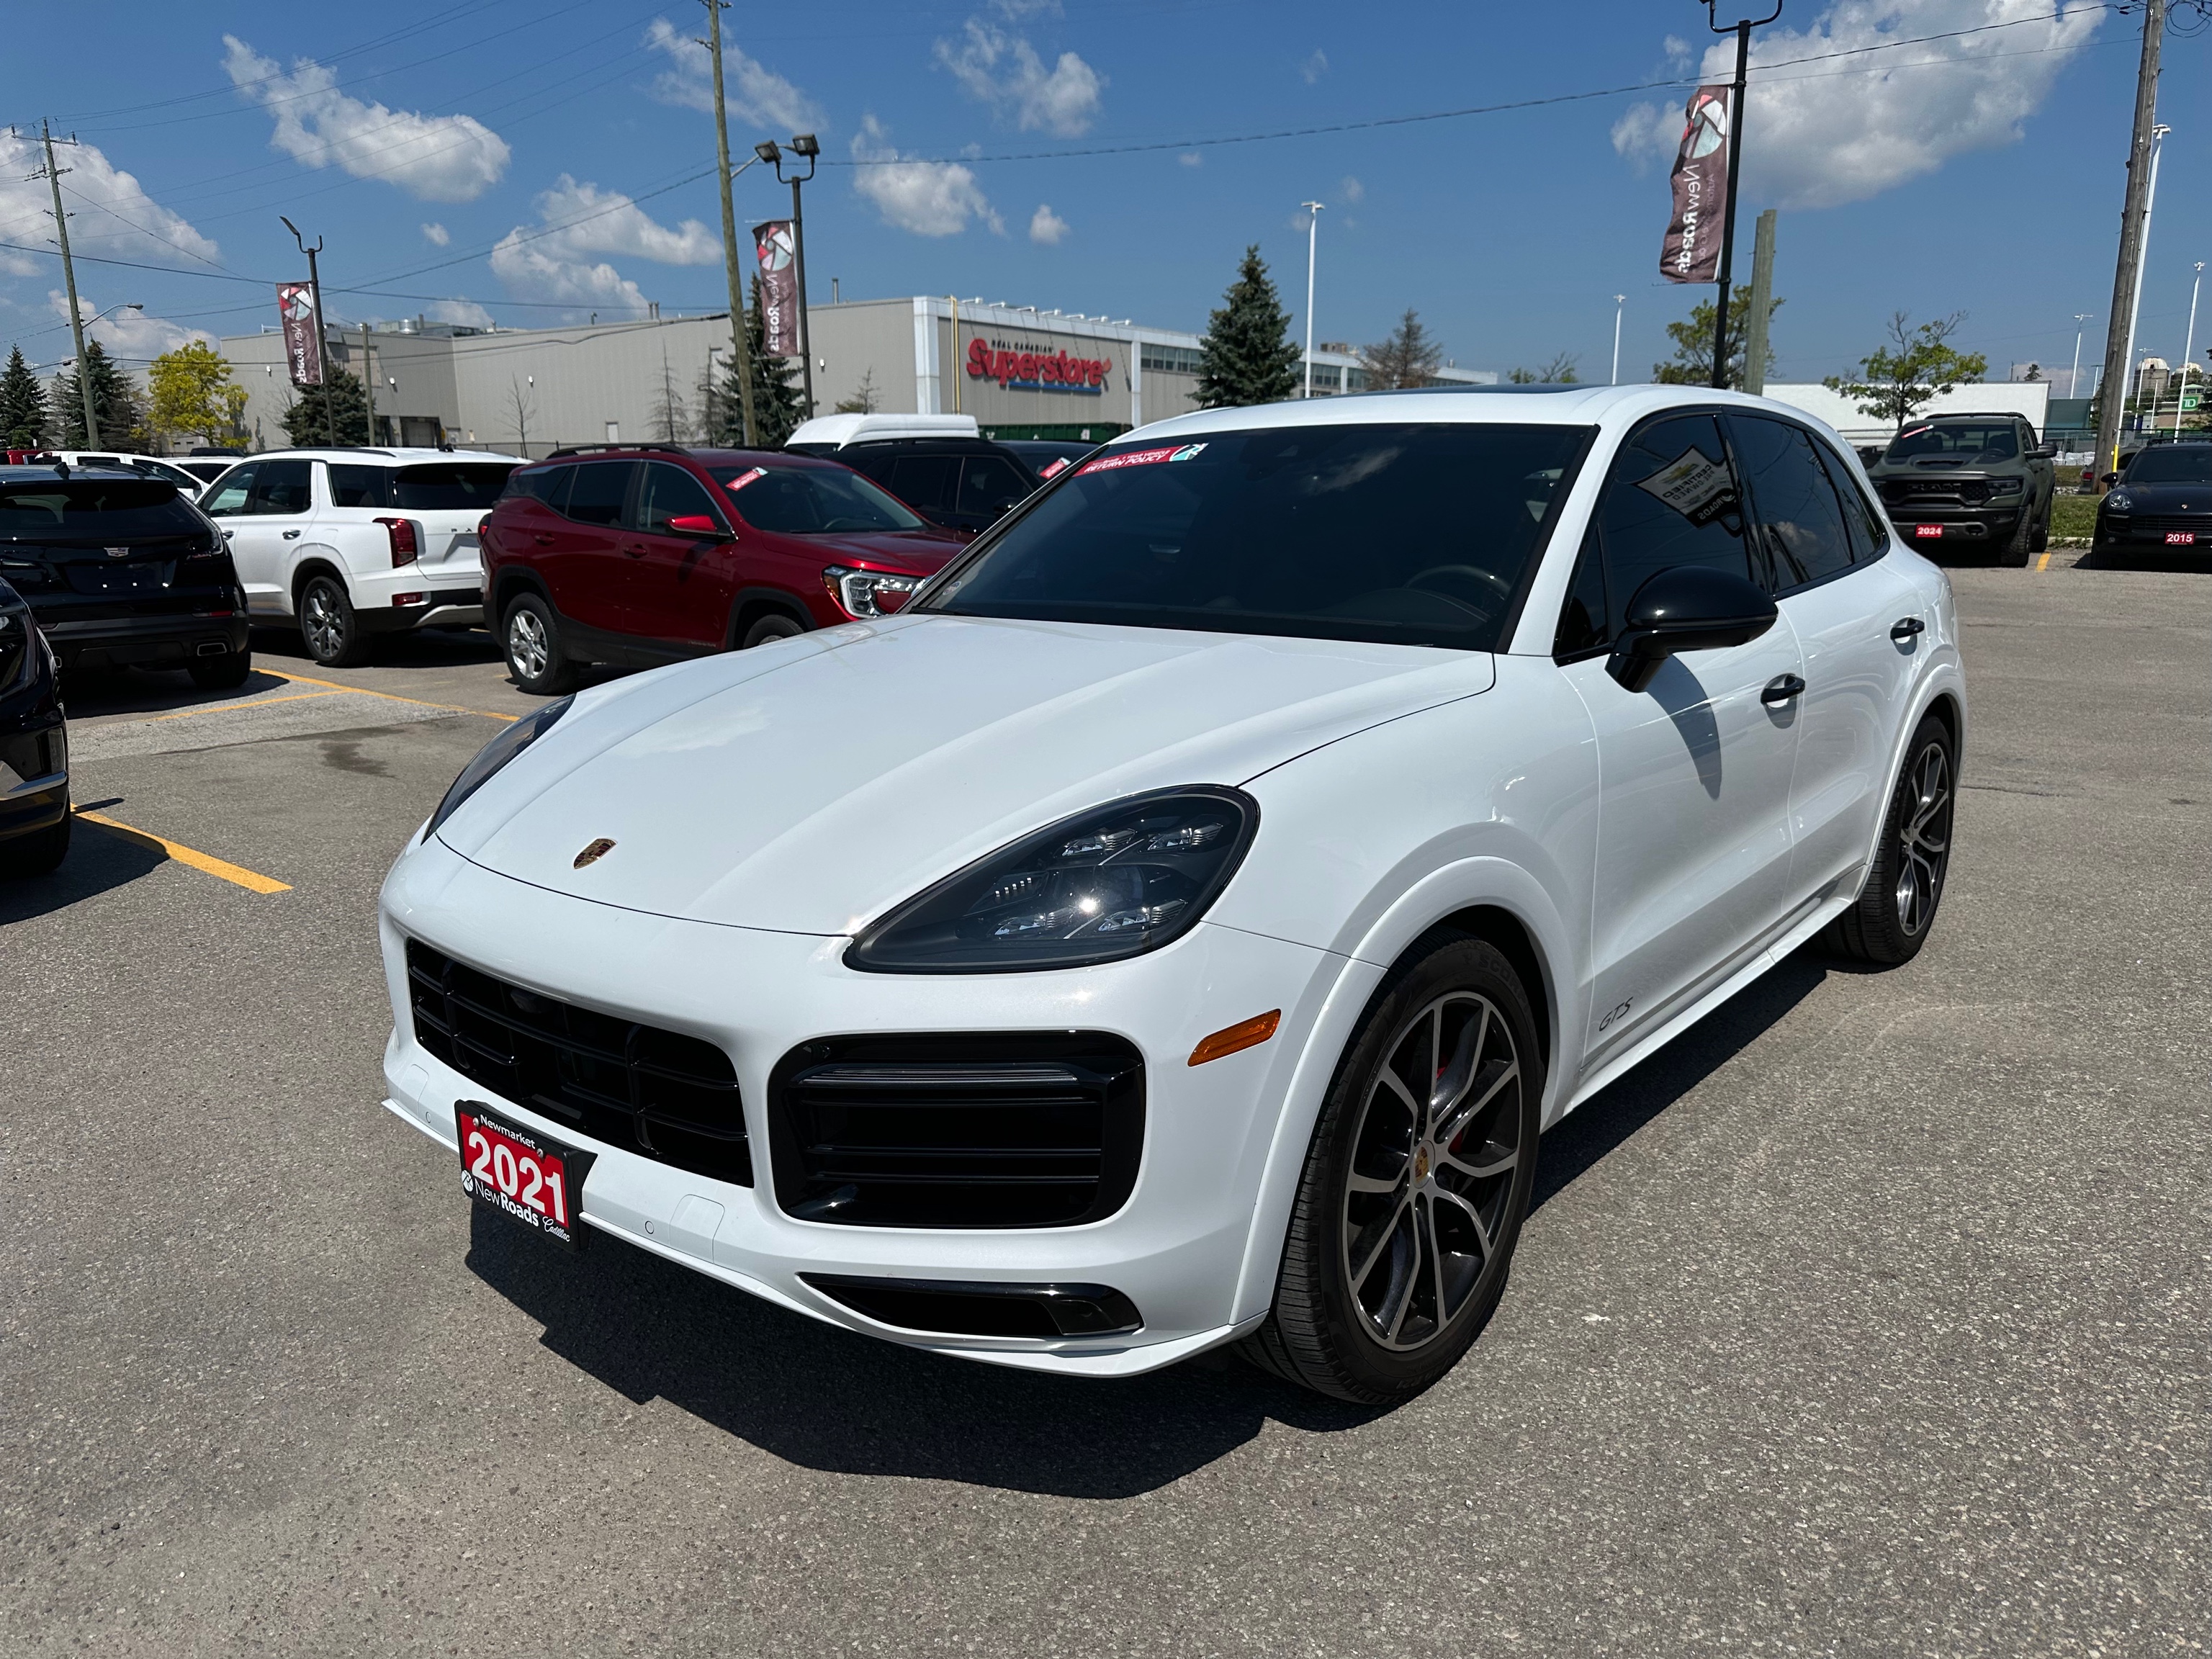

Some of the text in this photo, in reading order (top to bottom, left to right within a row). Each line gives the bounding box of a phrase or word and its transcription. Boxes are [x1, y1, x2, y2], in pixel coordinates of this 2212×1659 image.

[992, 339, 1053, 354] REAL CANADIAN
[966, 338, 1103, 386] Superstore
[2183, 398, 2196, 408] TD
[1084, 453, 1167, 473] RETURN POLICY
[1917, 526, 1942, 536] 2024
[2167, 533, 2193, 543] 2015
[1599, 997, 1634, 1032] GTS
[480, 1114, 536, 1150] Newmarket
[468, 1131, 565, 1224] 2021
[475, 1178, 539, 1227] NewRoads
[542, 1215, 570, 1242] Cadillac
